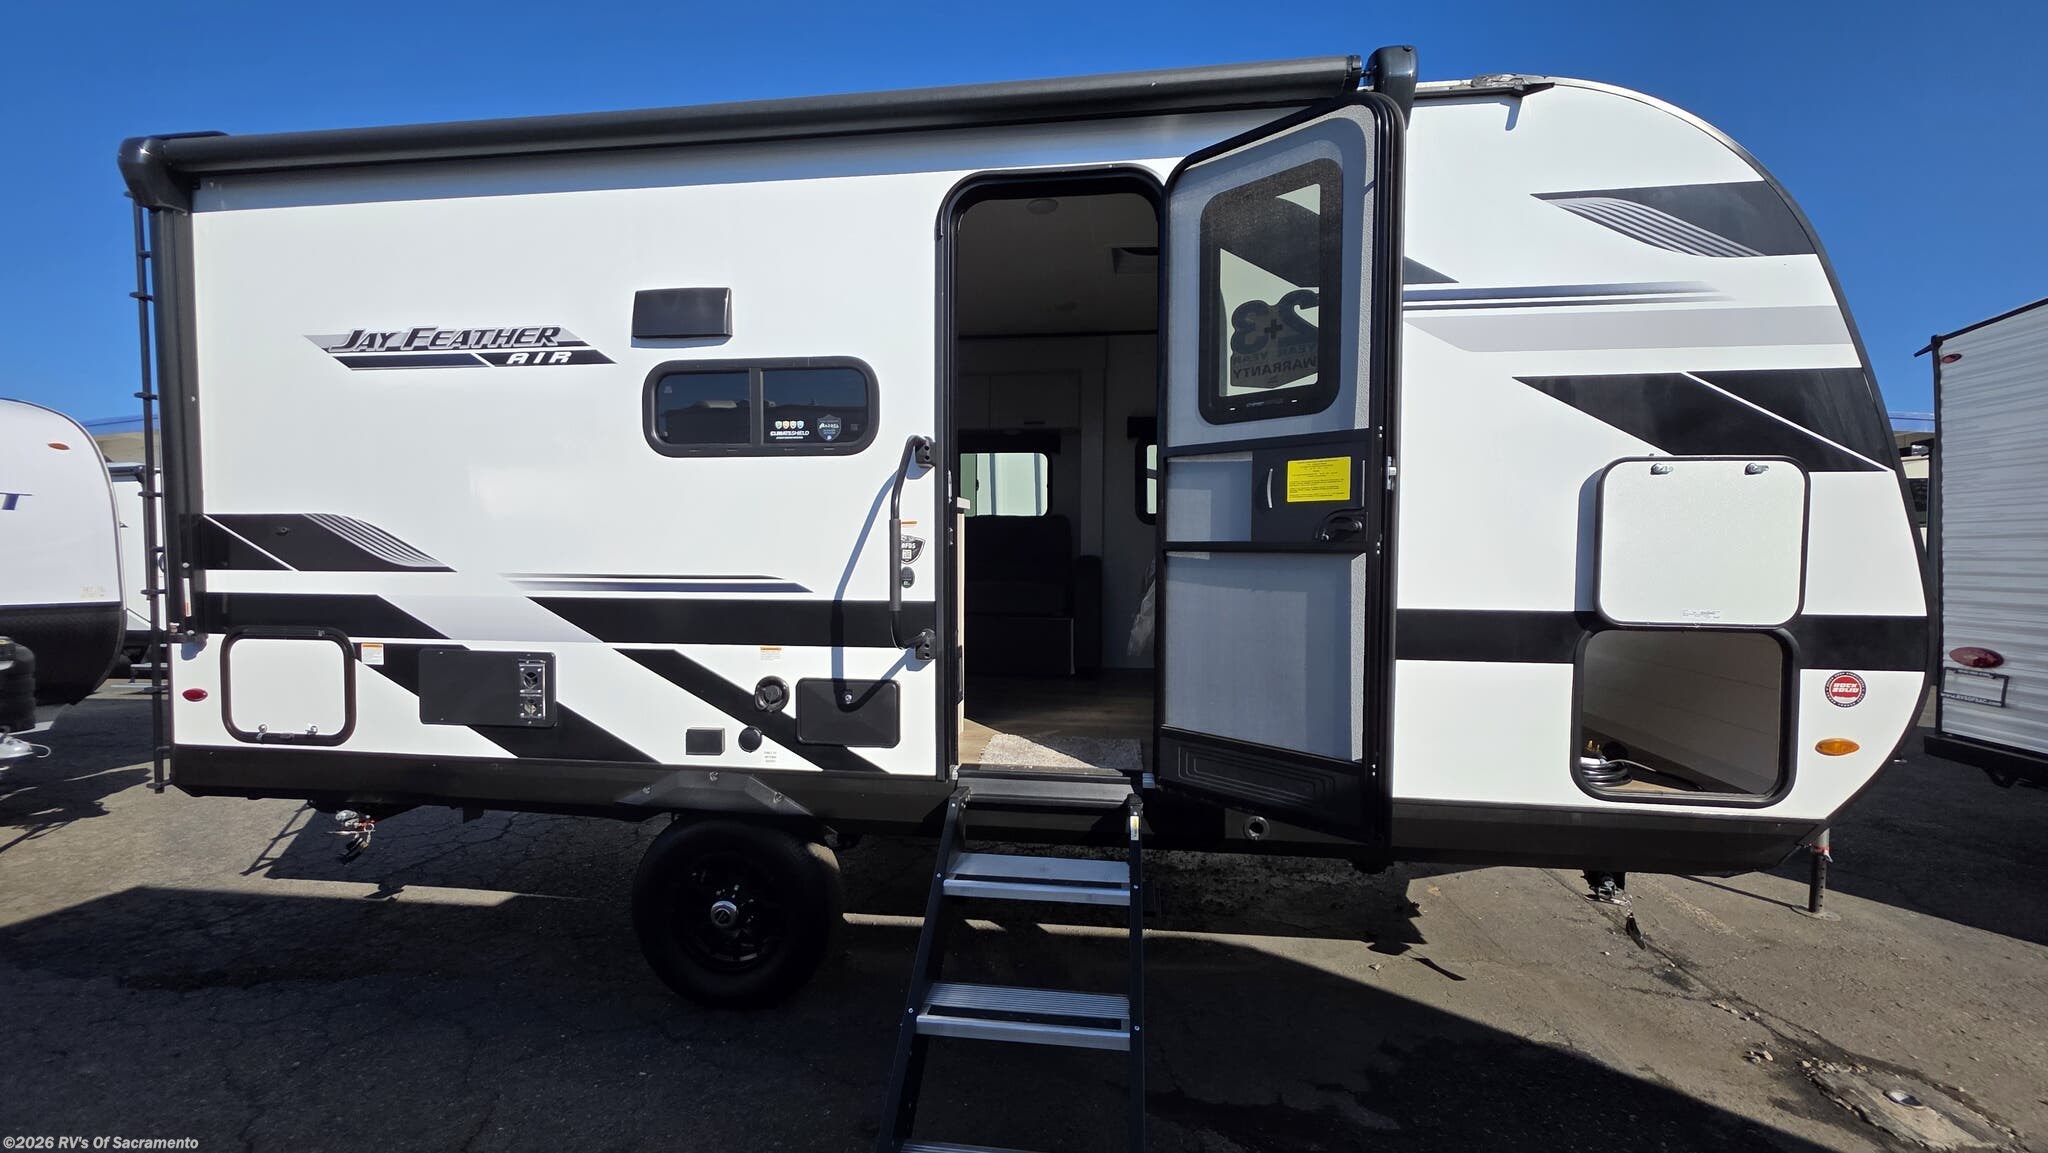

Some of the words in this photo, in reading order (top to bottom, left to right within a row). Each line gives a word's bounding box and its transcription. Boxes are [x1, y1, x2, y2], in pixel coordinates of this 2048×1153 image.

[329, 328, 398, 351] JAY
[403, 326, 561, 350] FEATHER
[506, 351, 572, 365] AIR
